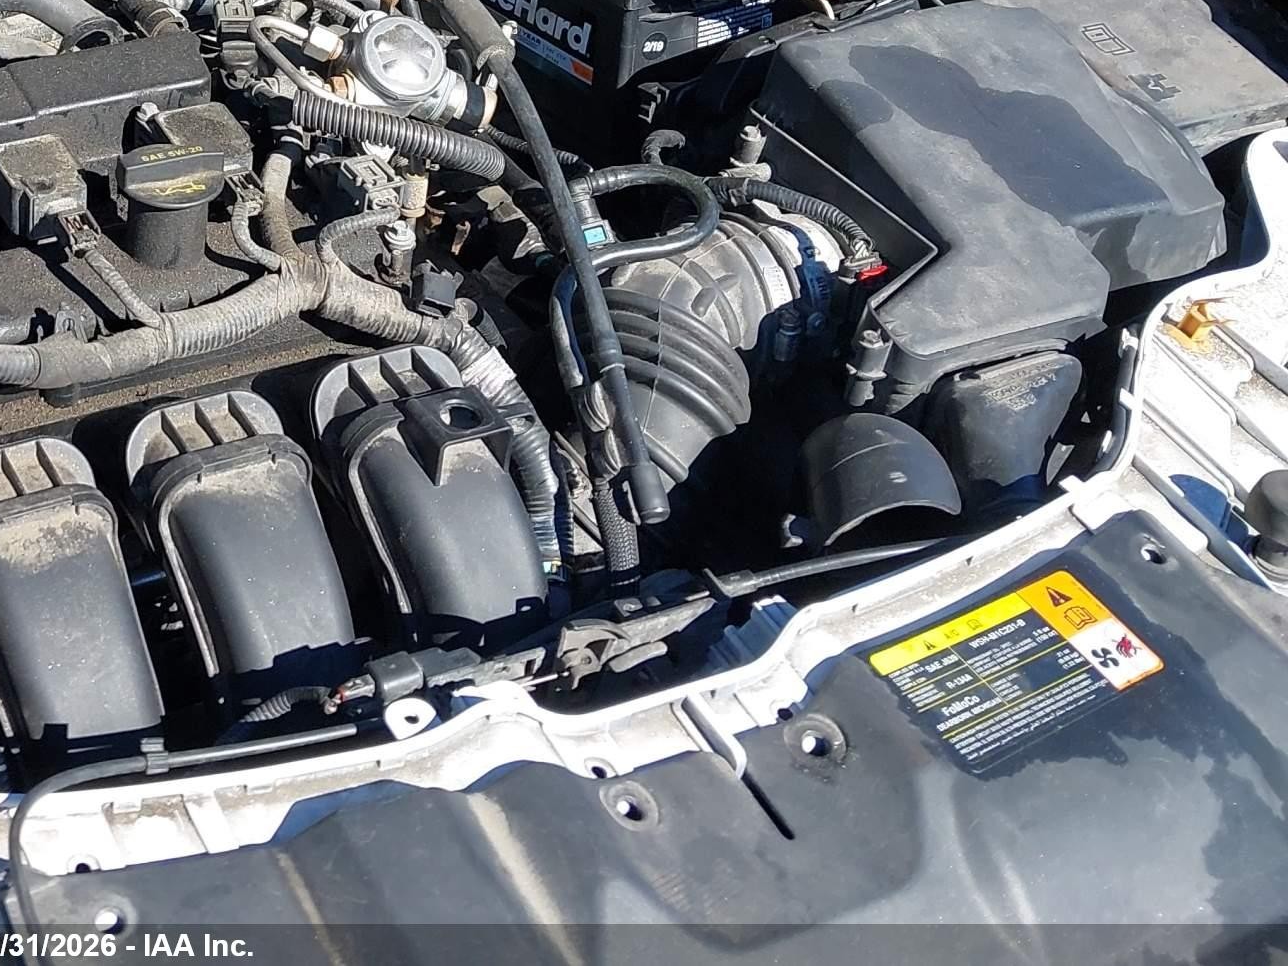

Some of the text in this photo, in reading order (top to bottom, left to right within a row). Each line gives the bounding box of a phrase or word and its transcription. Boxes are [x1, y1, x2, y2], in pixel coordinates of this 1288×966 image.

[643, 41, 664, 53] 2/19
[141, 146, 203, 162] SAE 5W-20
[923, 659, 944, 674] SAE
[940, 692, 981, 717] FoMoCo
